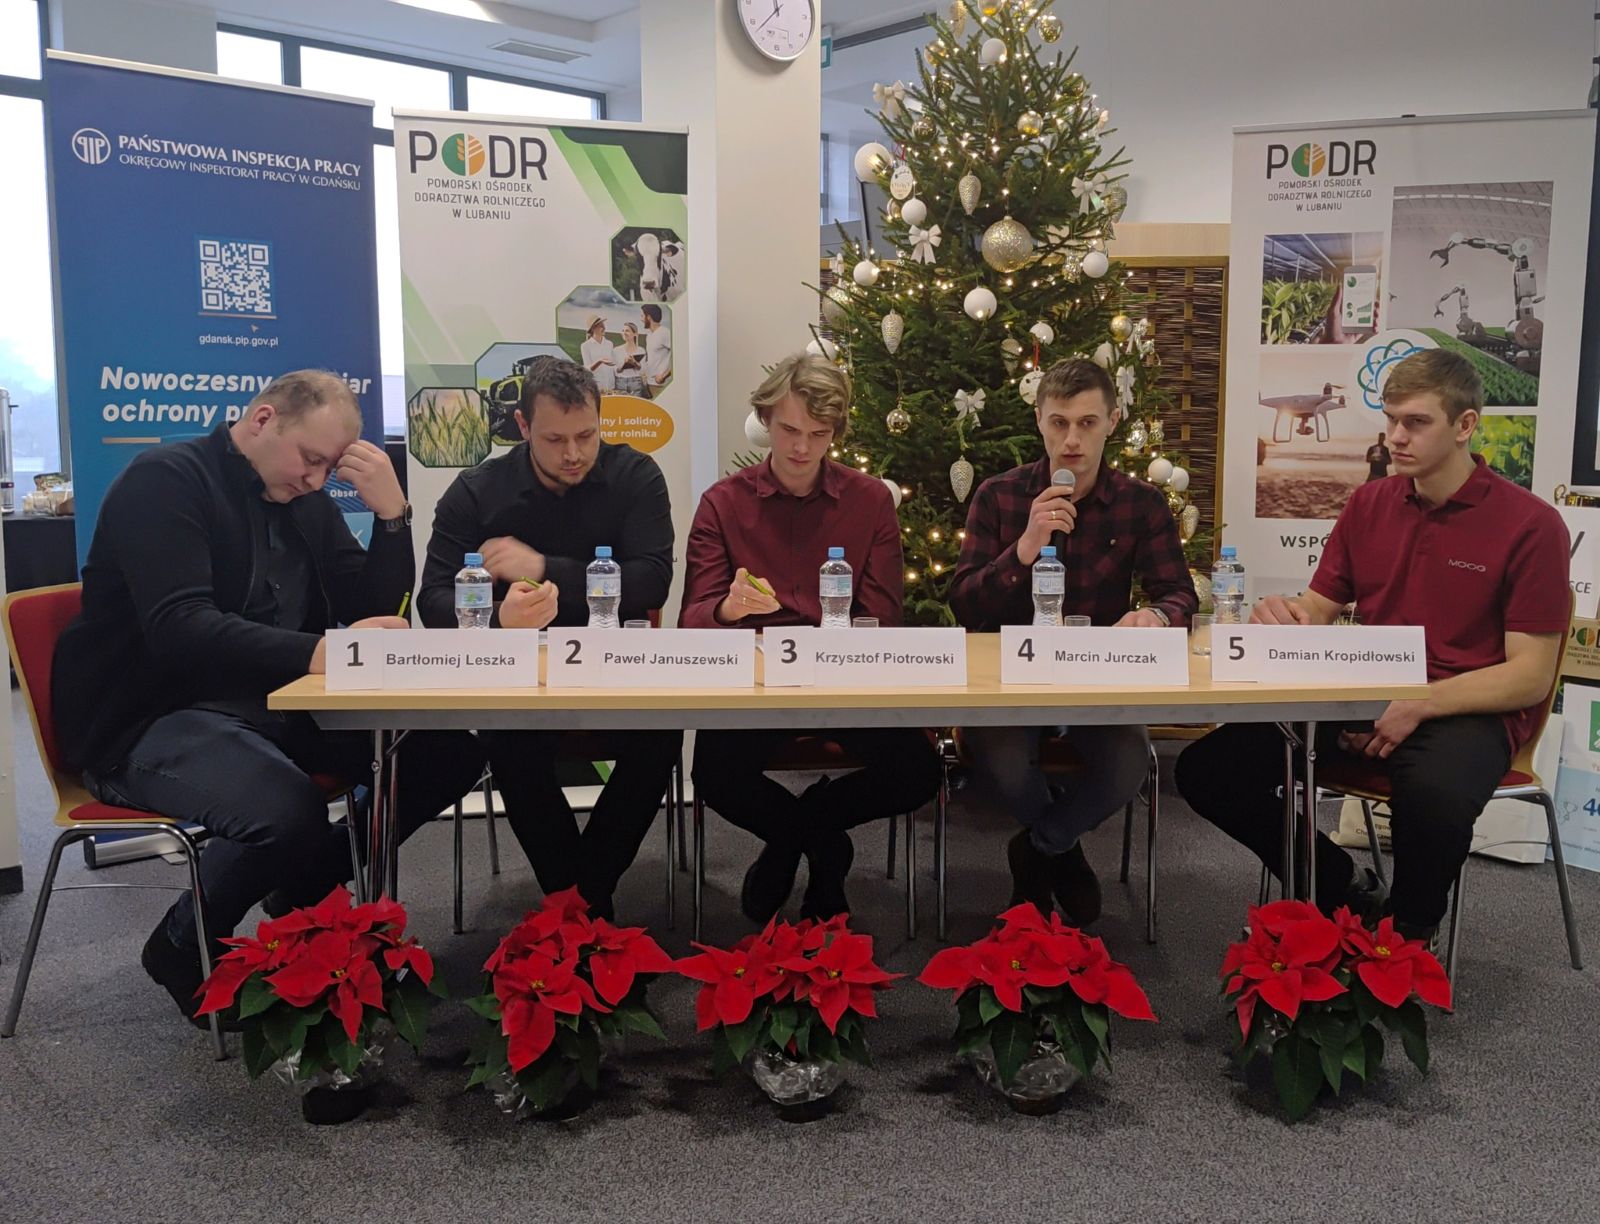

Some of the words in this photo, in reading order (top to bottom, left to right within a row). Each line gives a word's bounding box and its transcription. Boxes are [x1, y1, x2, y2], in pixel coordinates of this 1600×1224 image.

[118, 133, 228, 162] PAŃSTWOWA
[232, 149, 311, 172] INSPEKCJA
[314, 159, 362, 177] PRACY
[119, 153, 187, 171] OKRĘGOWY
[189, 162, 259, 179] INSPEKTORAT
[262, 170, 299, 183] PRACY
[298, 174, 310, 185] W
[312, 175, 362, 191] GDAŃSKU
[427, 178, 482, 191] POMORSKI
[485, 180, 533, 193] OŚRODEK
[1278, 179, 1321, 189] POMORSKI
[1323, 177, 1362, 188] OŚRODEK
[414, 191, 480, 205] DORADZTWA
[483, 196, 546, 209] ROLNICZEGO
[1267, 190, 1318, 201] DORADZTWA
[1321, 189, 1372, 200] ROLNICZEGO
[452, 209, 463, 219] W
[465, 209, 511, 220] LUBANIU
[1296, 203, 1303, 212] W
[1306, 201, 1342, 211] LUBANIU
[199, 334, 279, 347] gdansk.pip.gov.pl
[101, 366, 272, 392] Nowoczesny
[103, 399, 218, 427] ochrony
[624, 416, 662, 427] solidny
[621, 429, 657, 438] rolnika
[329, 488, 358, 499] Obser
[346, 642, 364, 667] 1
[565, 639, 582, 665] 2
[780, 638, 798, 664] 3
[1017, 638, 1035, 663] 4
[1228, 636, 1245, 661] 5
[1268, 648, 1320, 661] Damian
[1324, 648, 1416, 664] Kropidłowski
[386, 652, 461, 668] Bartłomiej
[466, 653, 516, 666] Leszka
[604, 651, 646, 665] Paweł
[650, 651, 738, 666] Januszewski
[815, 651, 880, 666] Krzysztof
[883, 651, 955, 665] Piotrowski
[1055, 649, 1100, 662] Marcin
[1104, 651, 1157, 665] Jurczak
